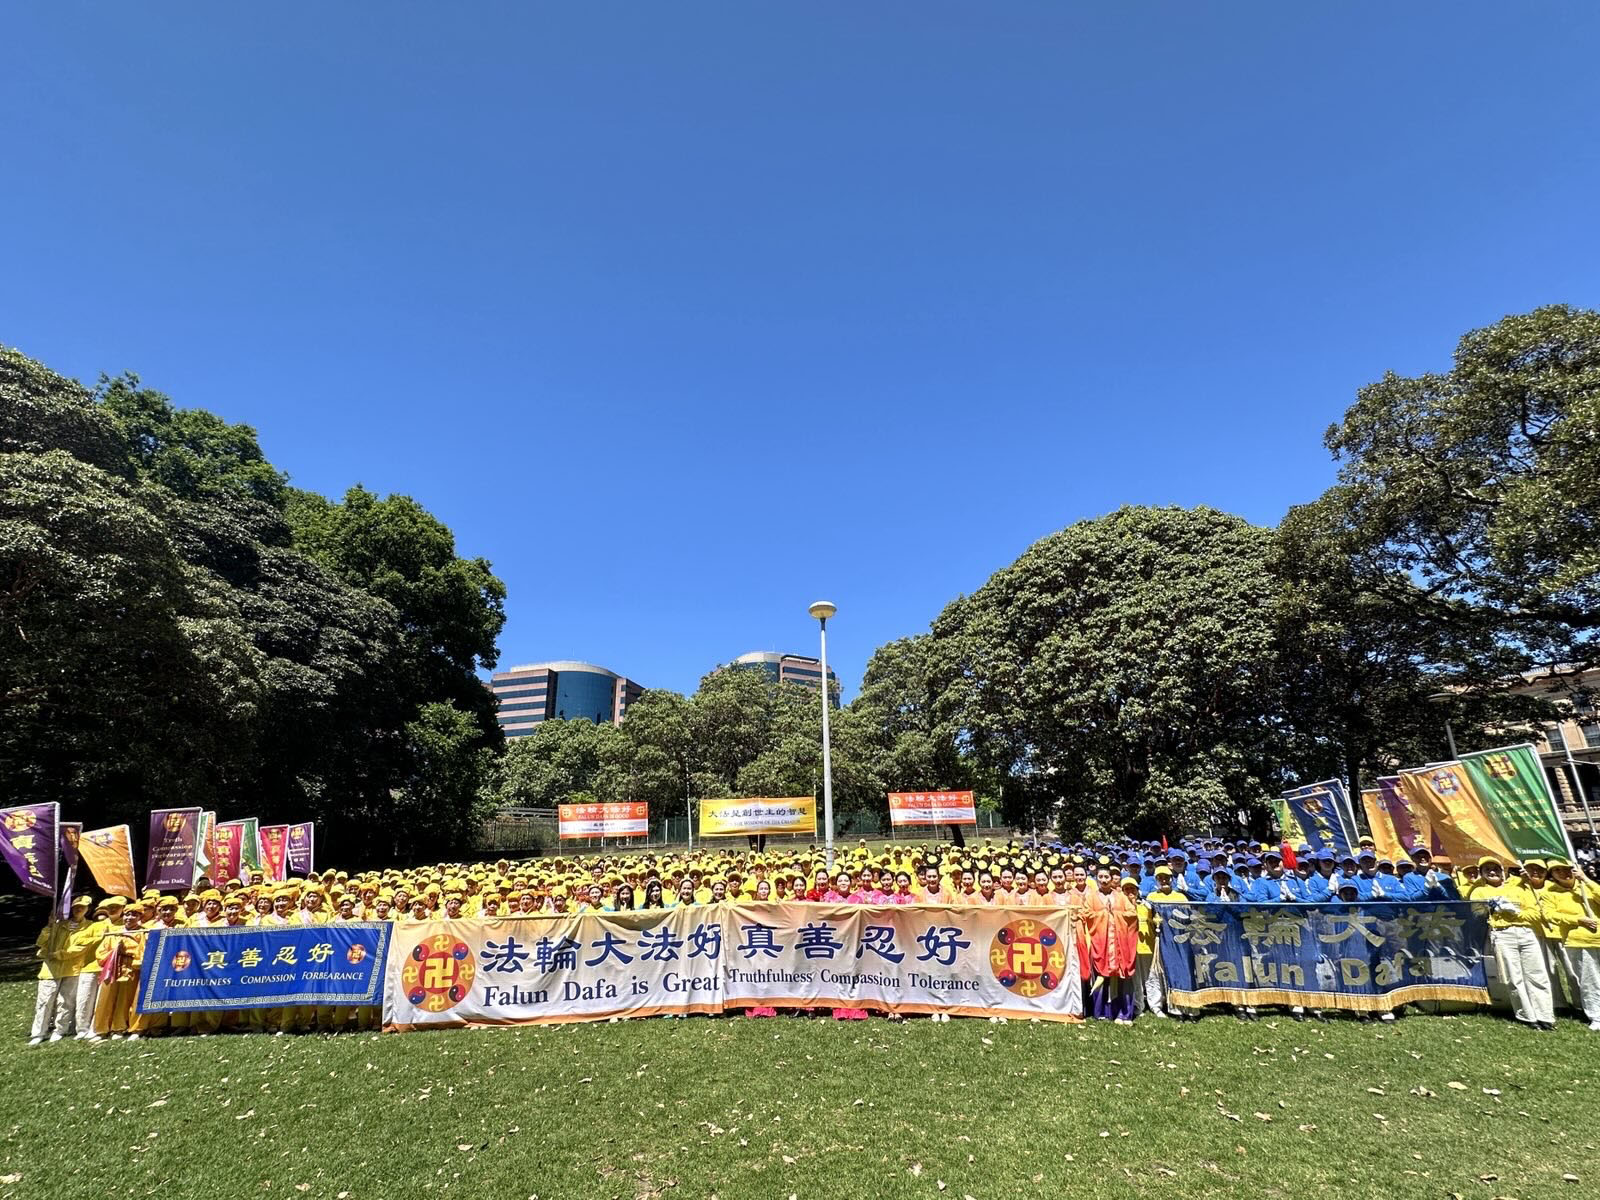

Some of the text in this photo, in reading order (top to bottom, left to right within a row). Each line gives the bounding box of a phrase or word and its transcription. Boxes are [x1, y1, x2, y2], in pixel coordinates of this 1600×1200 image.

[201, 943, 335, 970] 真善忍好
[480, 923, 722, 974] 法輪大法好
[737, 921, 971, 966] 真善忍好
[483, 971, 721, 1007] Falun Dafa is Great
[729, 968, 980, 992] Truthfulness Compassion Tolerance
